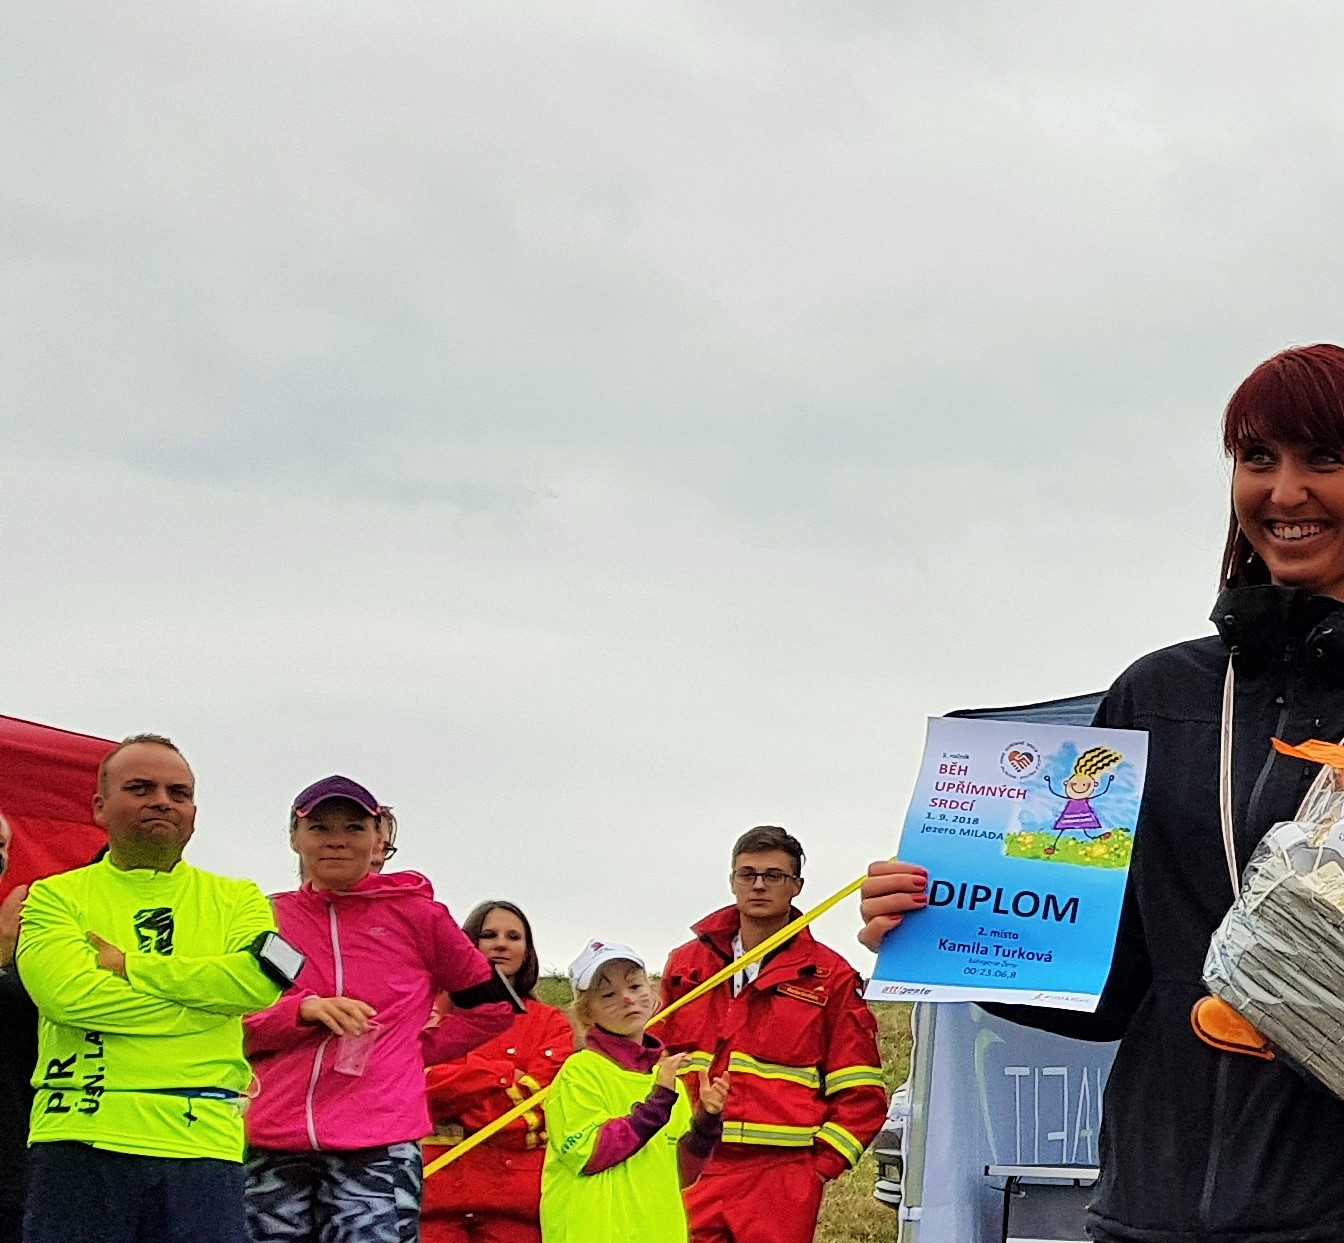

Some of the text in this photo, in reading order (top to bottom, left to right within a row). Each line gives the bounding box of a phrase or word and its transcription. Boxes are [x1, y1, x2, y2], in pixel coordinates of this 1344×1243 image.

[938, 761, 969, 776] BĚH
[934, 780, 1028, 800] UPŘÍMNÝCH
[928, 797, 976, 812] SRDCÍ
[951, 815, 980, 825] 2018
[920, 823, 1004, 840] jezero MILADA
[928, 879, 1080, 924] DIPLOM
[990, 929, 1019, 941] místo
[938, 937, 1053, 963] Kamila Turková
